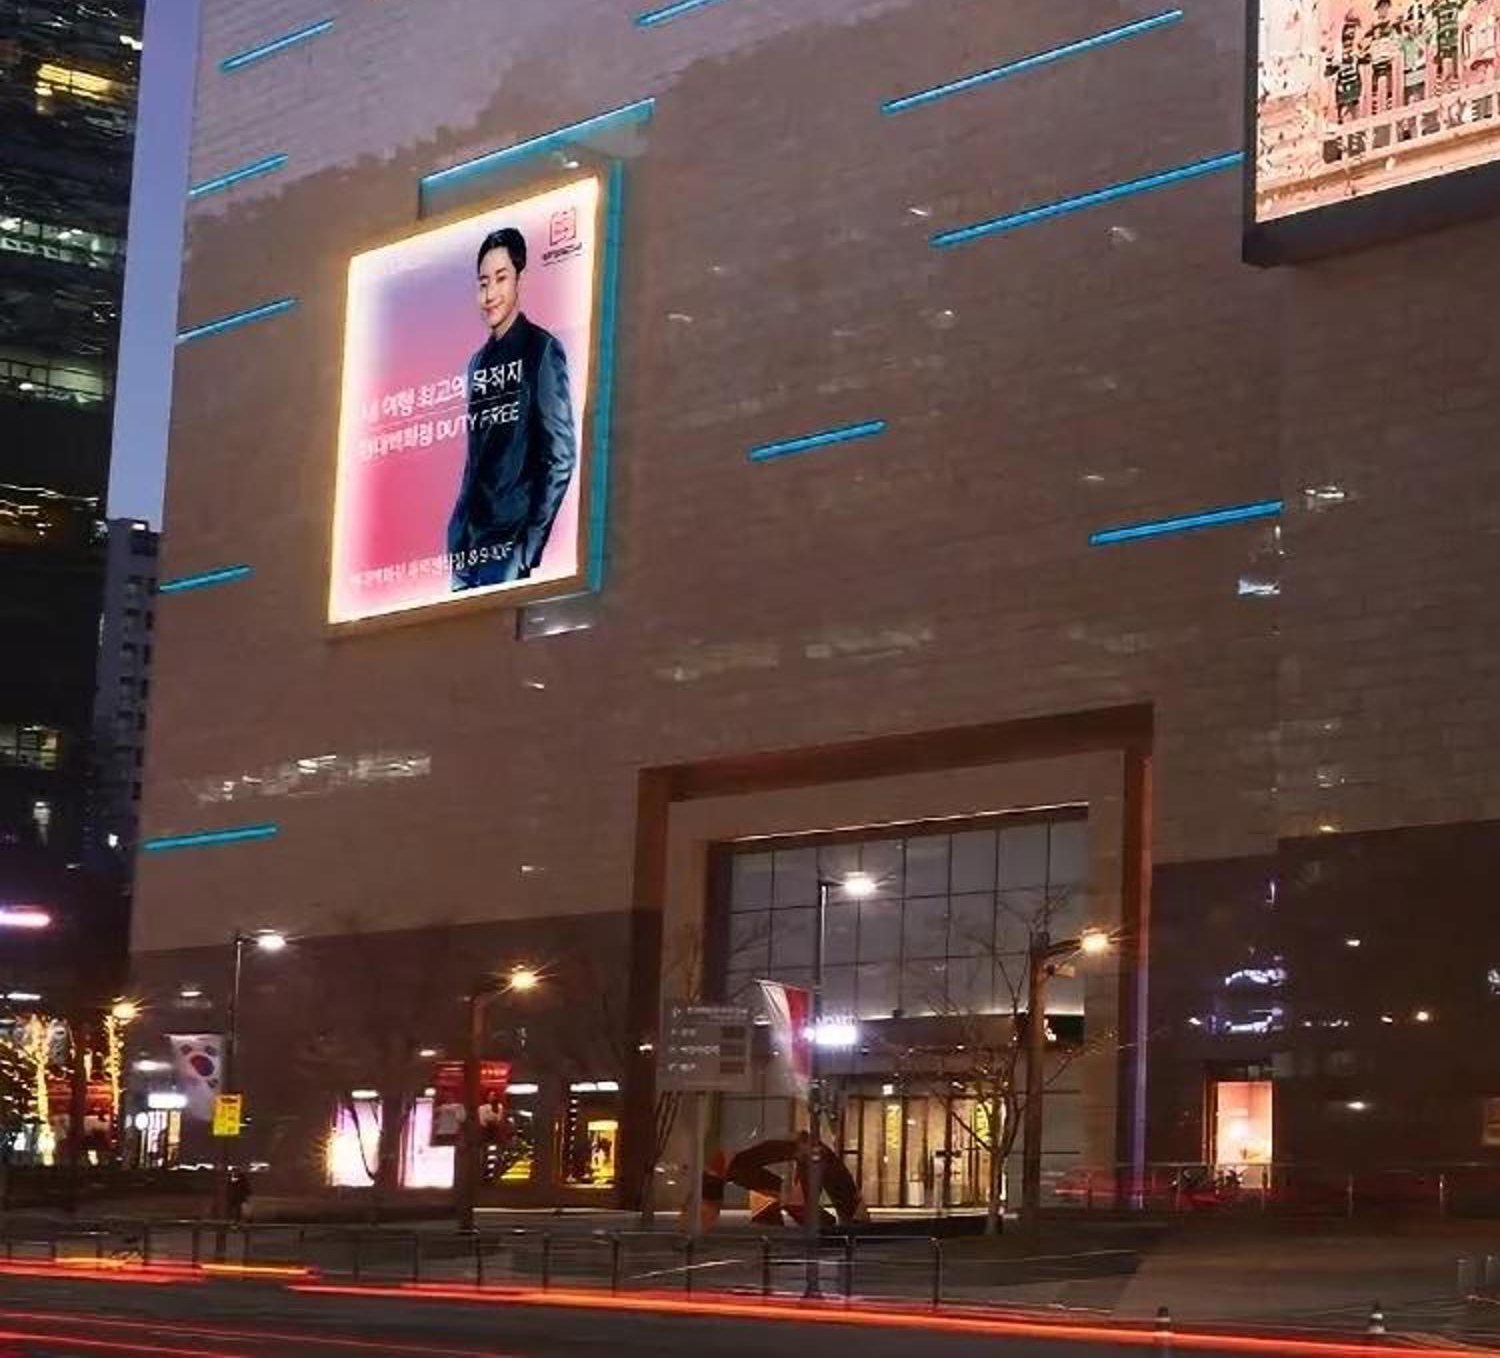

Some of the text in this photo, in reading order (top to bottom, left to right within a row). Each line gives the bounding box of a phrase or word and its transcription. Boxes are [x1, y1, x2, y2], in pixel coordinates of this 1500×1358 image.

[416, 376, 468, 407] 최고의
[473, 359, 523, 394] 목적지
[437, 413, 478, 442] DUTY
[480, 401, 519, 429] FREE
